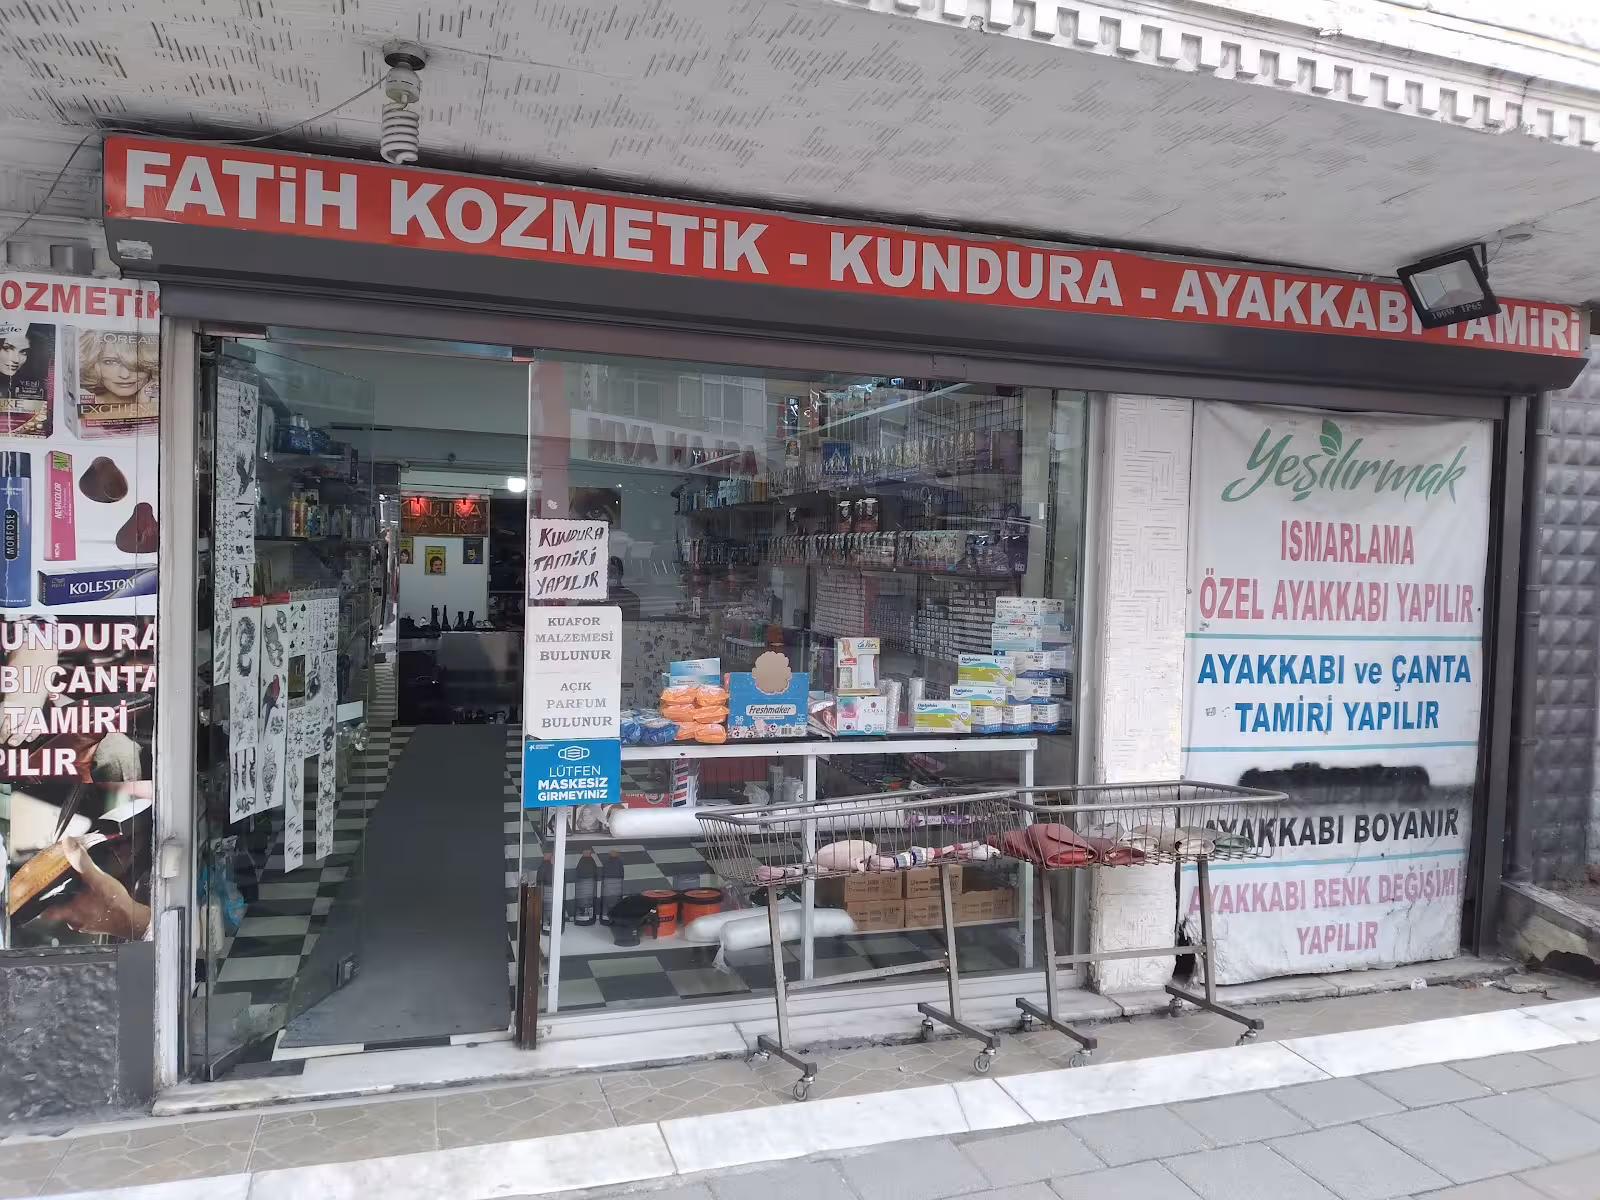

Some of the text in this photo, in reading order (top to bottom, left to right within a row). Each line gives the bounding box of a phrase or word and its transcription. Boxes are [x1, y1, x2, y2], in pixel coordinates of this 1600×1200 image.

[829, 231, 1123, 307] KUNDURA
[1171, 268, 1423, 335] AYAKKABI
[1431, 300, 1482, 320] 100W IP65
[6, 513, 15, 556] MORFOSE
[537, 526, 605, 548] KUNDURA
[1280, 519, 1415, 565] ISMARLAMA
[69, 578, 136, 595] KOLESTON
[536, 570, 600, 596] YAPILIR
[1199, 567, 1474, 623] ÖZEL AYAKKABI YAPILIR
[1, 622, 156, 651] UNDURA
[535, 631, 614, 643] MALZEMESİ
[539, 649, 612, 661] BULUNUR
[1197, 653, 1472, 692] AYAKKABI ve ÇANTA
[560, 682, 592, 694] AÇIK
[4, 699, 129, 735] TAMİRİ
[546, 698, 607, 710] PARFUM
[748, 703, 792, 715] Freshmaker
[1235, 694, 1440, 732] TAMİRİ YAPILIR
[541, 716, 613, 729] BULUNUR
[549, 764, 601, 778] LÜTFEN
[1353, 807, 1460, 843] BOYANIR
[1314, 875, 1371, 909] RENK
[1296, 920, 1379, 956] YAPILIR
